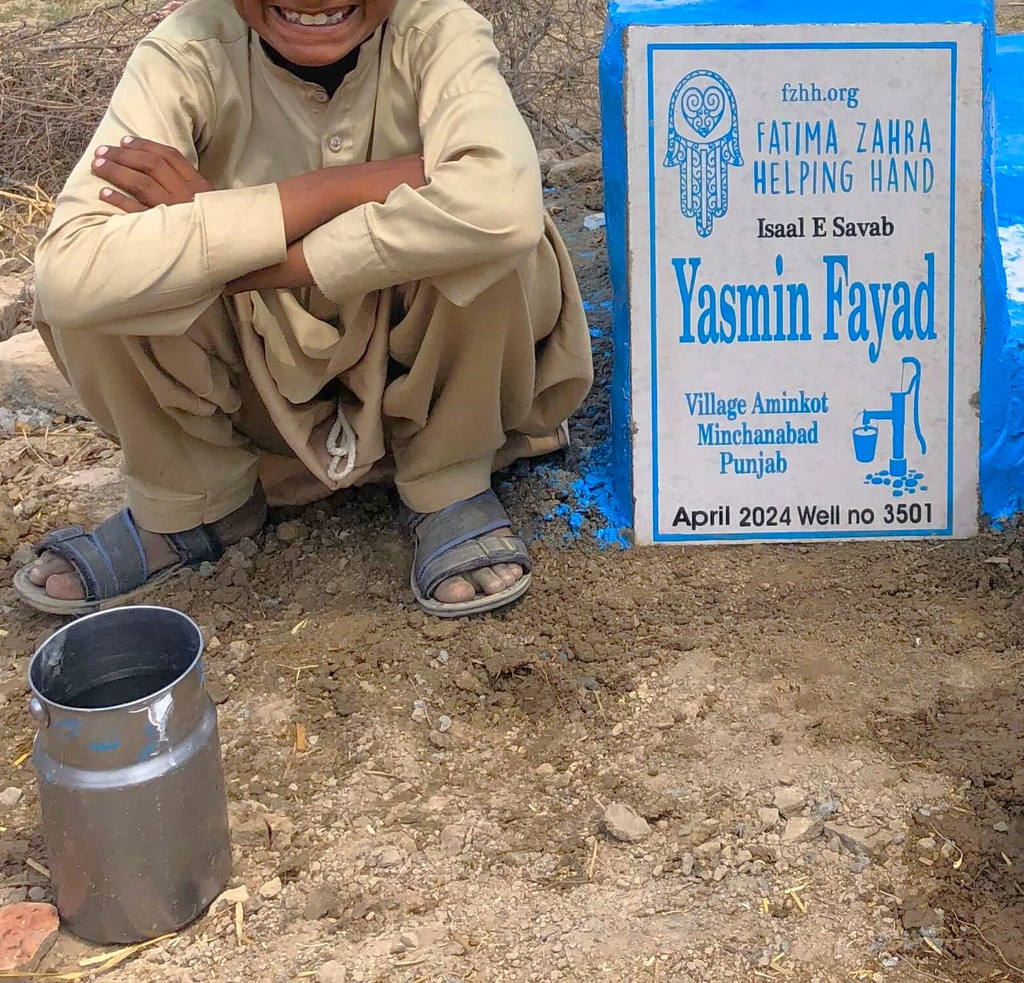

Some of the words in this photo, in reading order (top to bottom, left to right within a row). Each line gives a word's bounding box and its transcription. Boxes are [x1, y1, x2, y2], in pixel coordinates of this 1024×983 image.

[781, 83, 860, 109] fzhh.org
[756, 119, 839, 156] FATIMA
[855, 118, 932, 155] ZAHRA
[752, 159, 853, 196] HELPING
[870, 157, 935, 194] HAND
[757, 217, 805, 239] Isaal
[811, 217, 827, 238] E
[832, 215, 895, 238] Savab
[671, 254, 812, 345] Yasmin
[822, 252, 938, 364] Fayad
[684, 392, 748, 421] Village
[751, 390, 829, 415] Aminkot
[697, 421, 819, 447] Minchanabad
[719, 451, 788, 479] Punjab
[672, 505, 730, 531] April
[739, 506, 792, 527] 2024
[797, 505, 841, 526] Well
[848, 508, 875, 525] no
[883, 503, 933, 524] 3501
